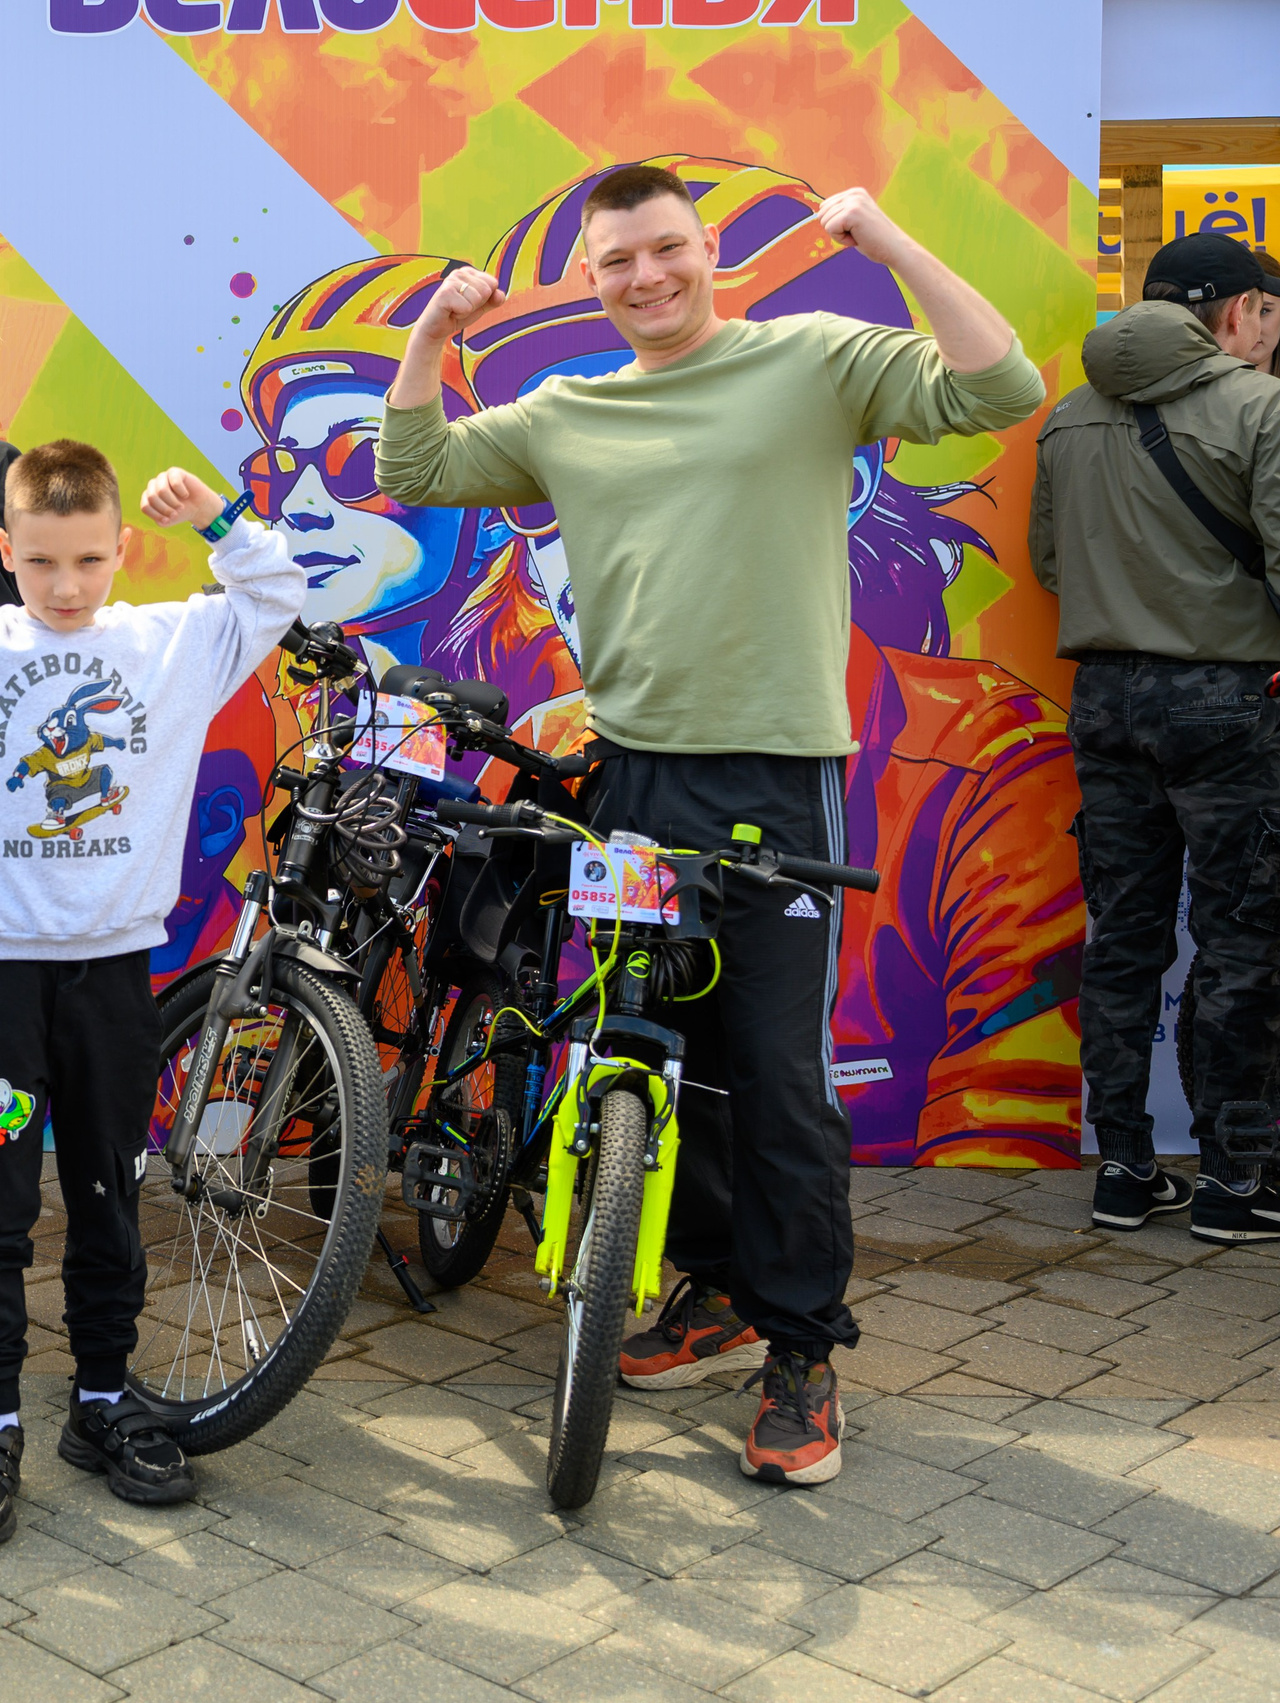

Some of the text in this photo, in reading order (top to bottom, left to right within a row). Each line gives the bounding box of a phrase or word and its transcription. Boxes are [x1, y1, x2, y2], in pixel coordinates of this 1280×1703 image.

[3, 836, 132, 859] NO BREAKS
[572, 889, 616, 904] 05852
[784, 907, 820, 919] adidas
[1106, 1166, 1122, 1174] NIKE
